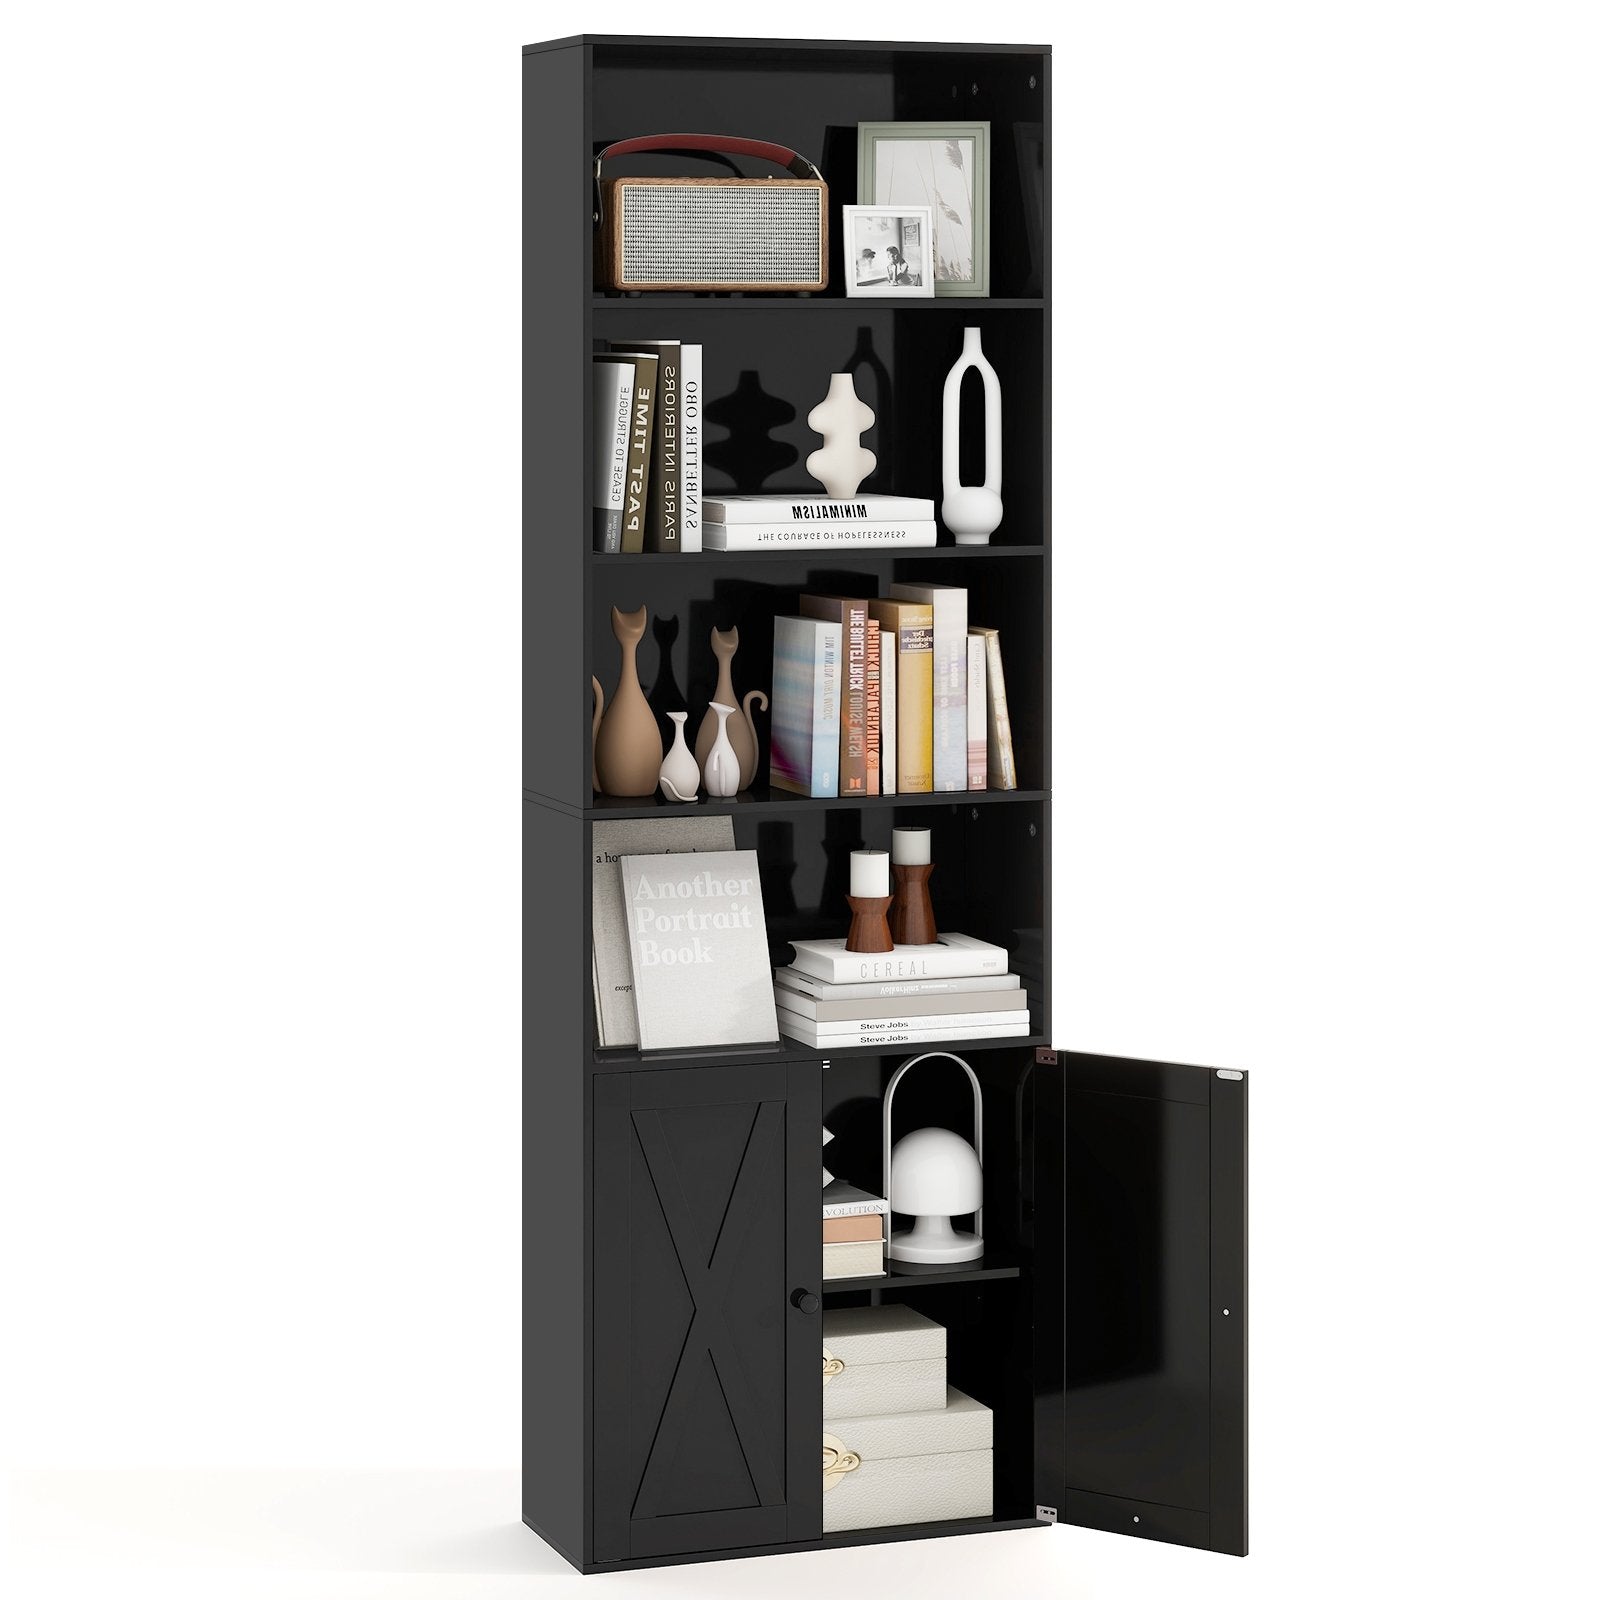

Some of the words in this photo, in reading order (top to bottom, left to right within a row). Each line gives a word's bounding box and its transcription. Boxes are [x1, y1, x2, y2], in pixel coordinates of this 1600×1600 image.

[633, 872, 753, 900] Another
[636, 903, 752, 934] Portrait
[639, 938, 714, 966] Book
[860, 960, 927, 978] CEREAL
[860, 1036, 886, 1044] Steve
[887, 1034, 908, 1042] Jobs
[823, 1204, 883, 1216] VOLUTION
